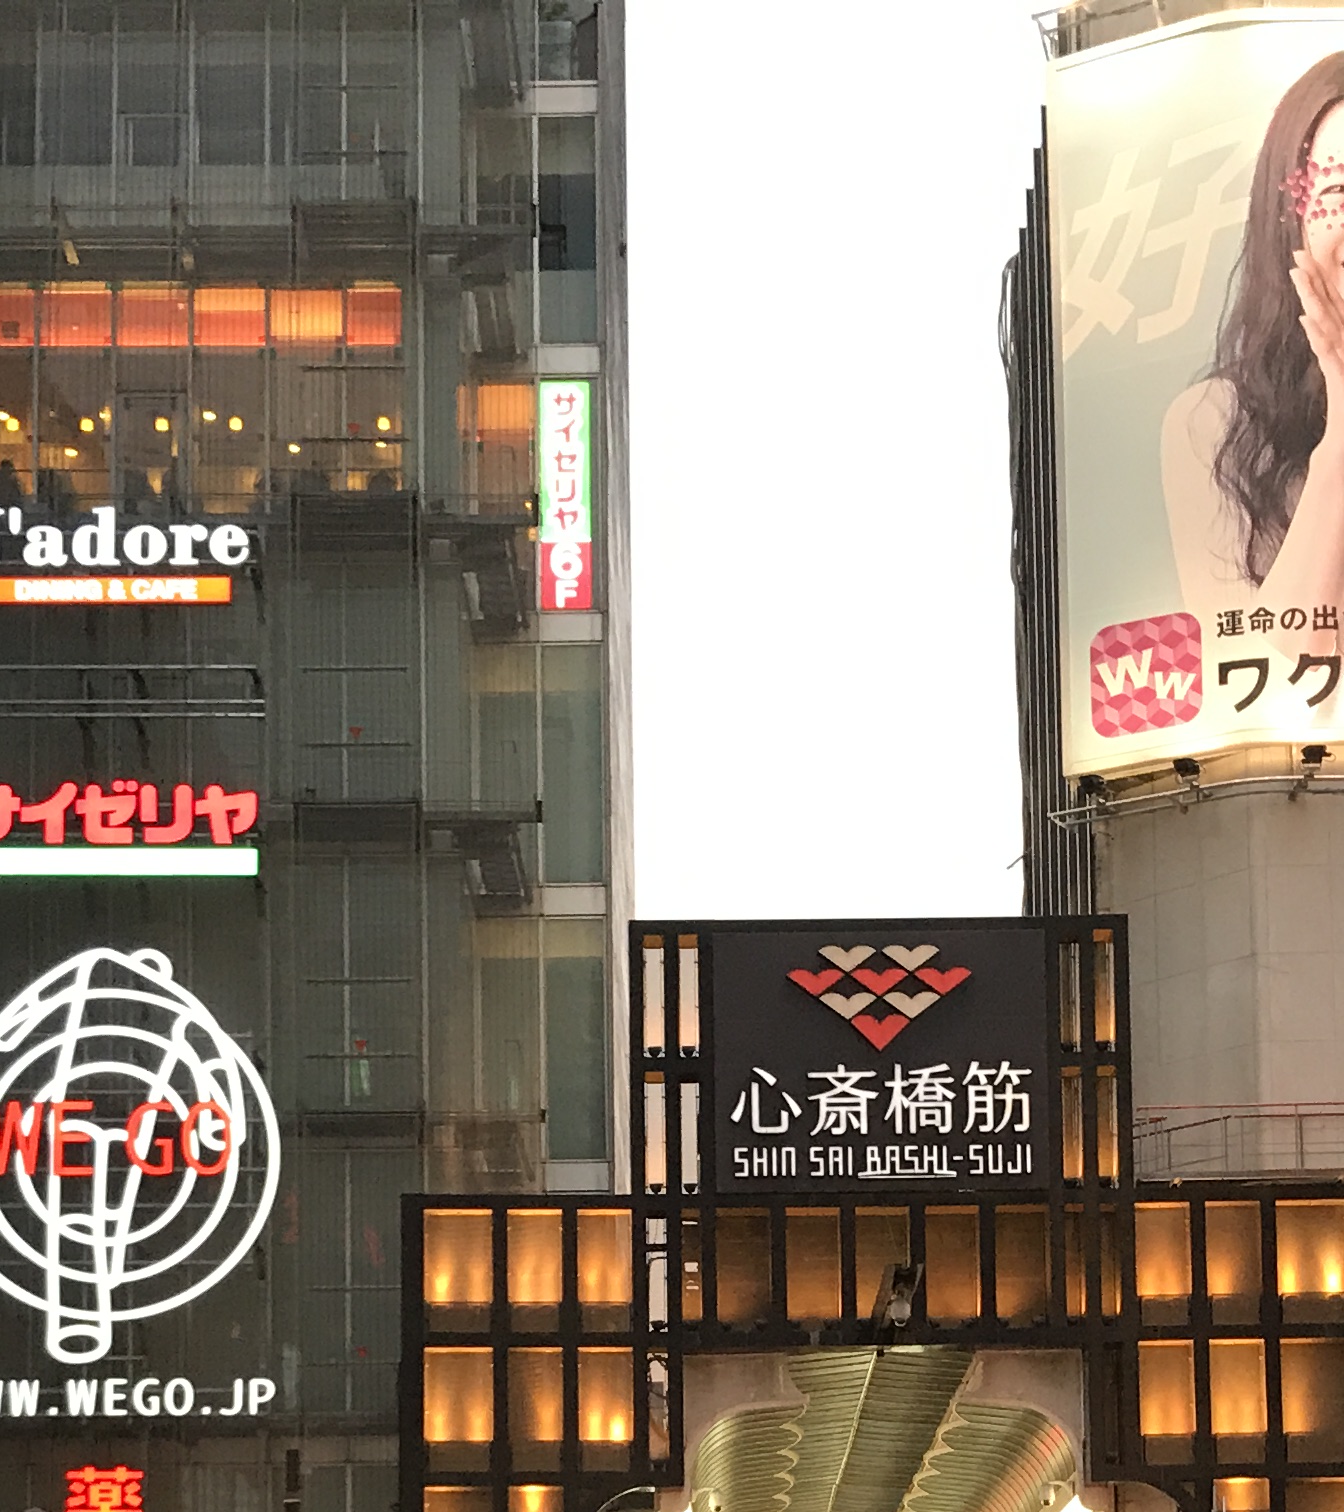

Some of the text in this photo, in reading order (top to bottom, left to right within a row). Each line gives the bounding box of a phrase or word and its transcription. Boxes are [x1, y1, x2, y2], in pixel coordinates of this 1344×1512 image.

[13, 578, 199, 601] DINING & CAFE
[730, 1061, 1033, 1137] 心斎橋筋
[734, 1147, 796, 1177] SHIN
[809, 1146, 853, 1176] SAI
